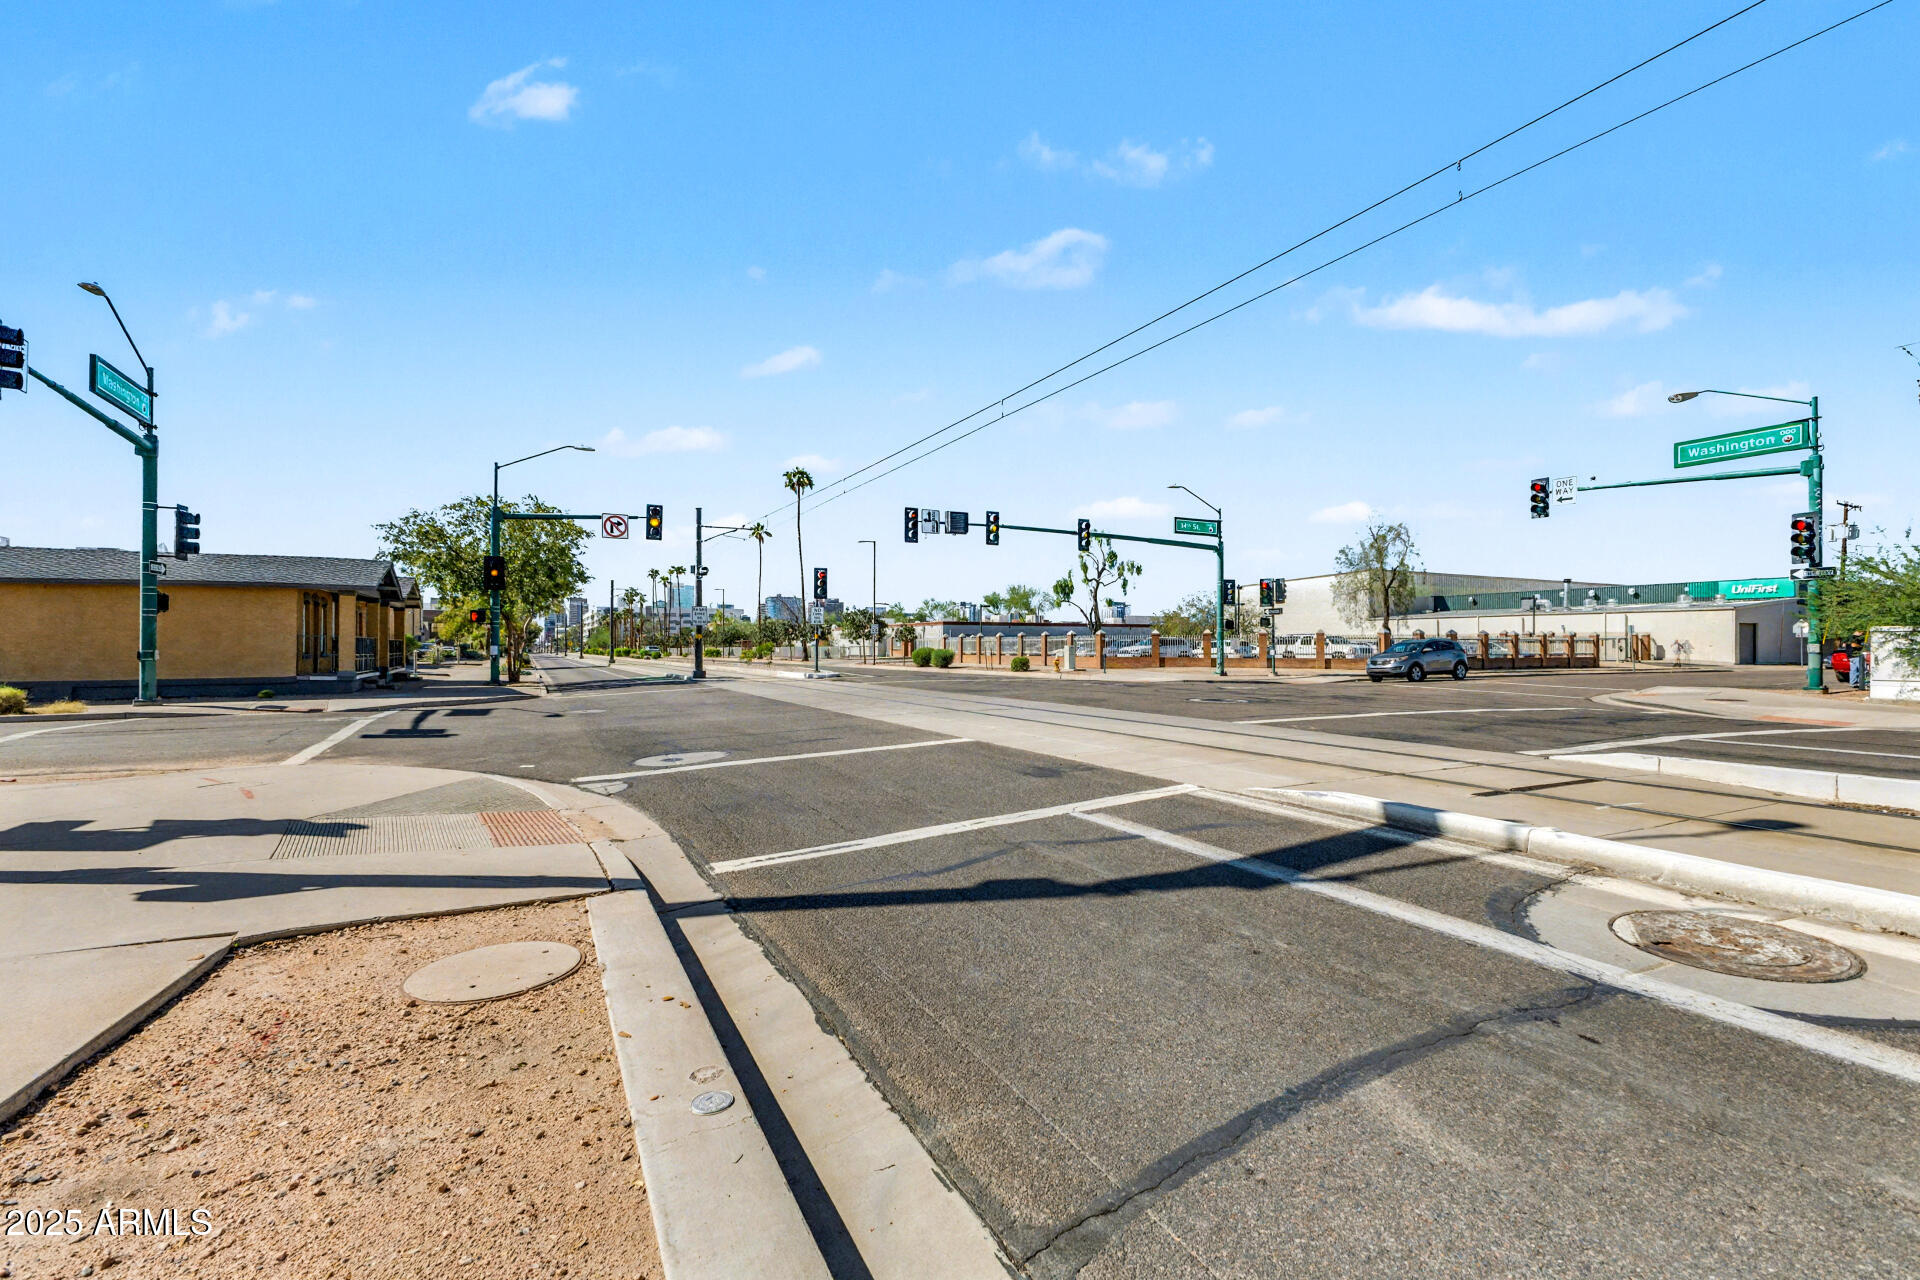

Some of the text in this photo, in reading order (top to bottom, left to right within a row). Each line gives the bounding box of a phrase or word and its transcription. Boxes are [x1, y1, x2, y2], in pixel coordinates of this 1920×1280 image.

[1688, 436, 1775, 457] Washington
[1556, 479, 1573, 487] ONE
[1556, 487, 1573, 495] WAY
[1731, 584, 1778, 594] UniFirst
